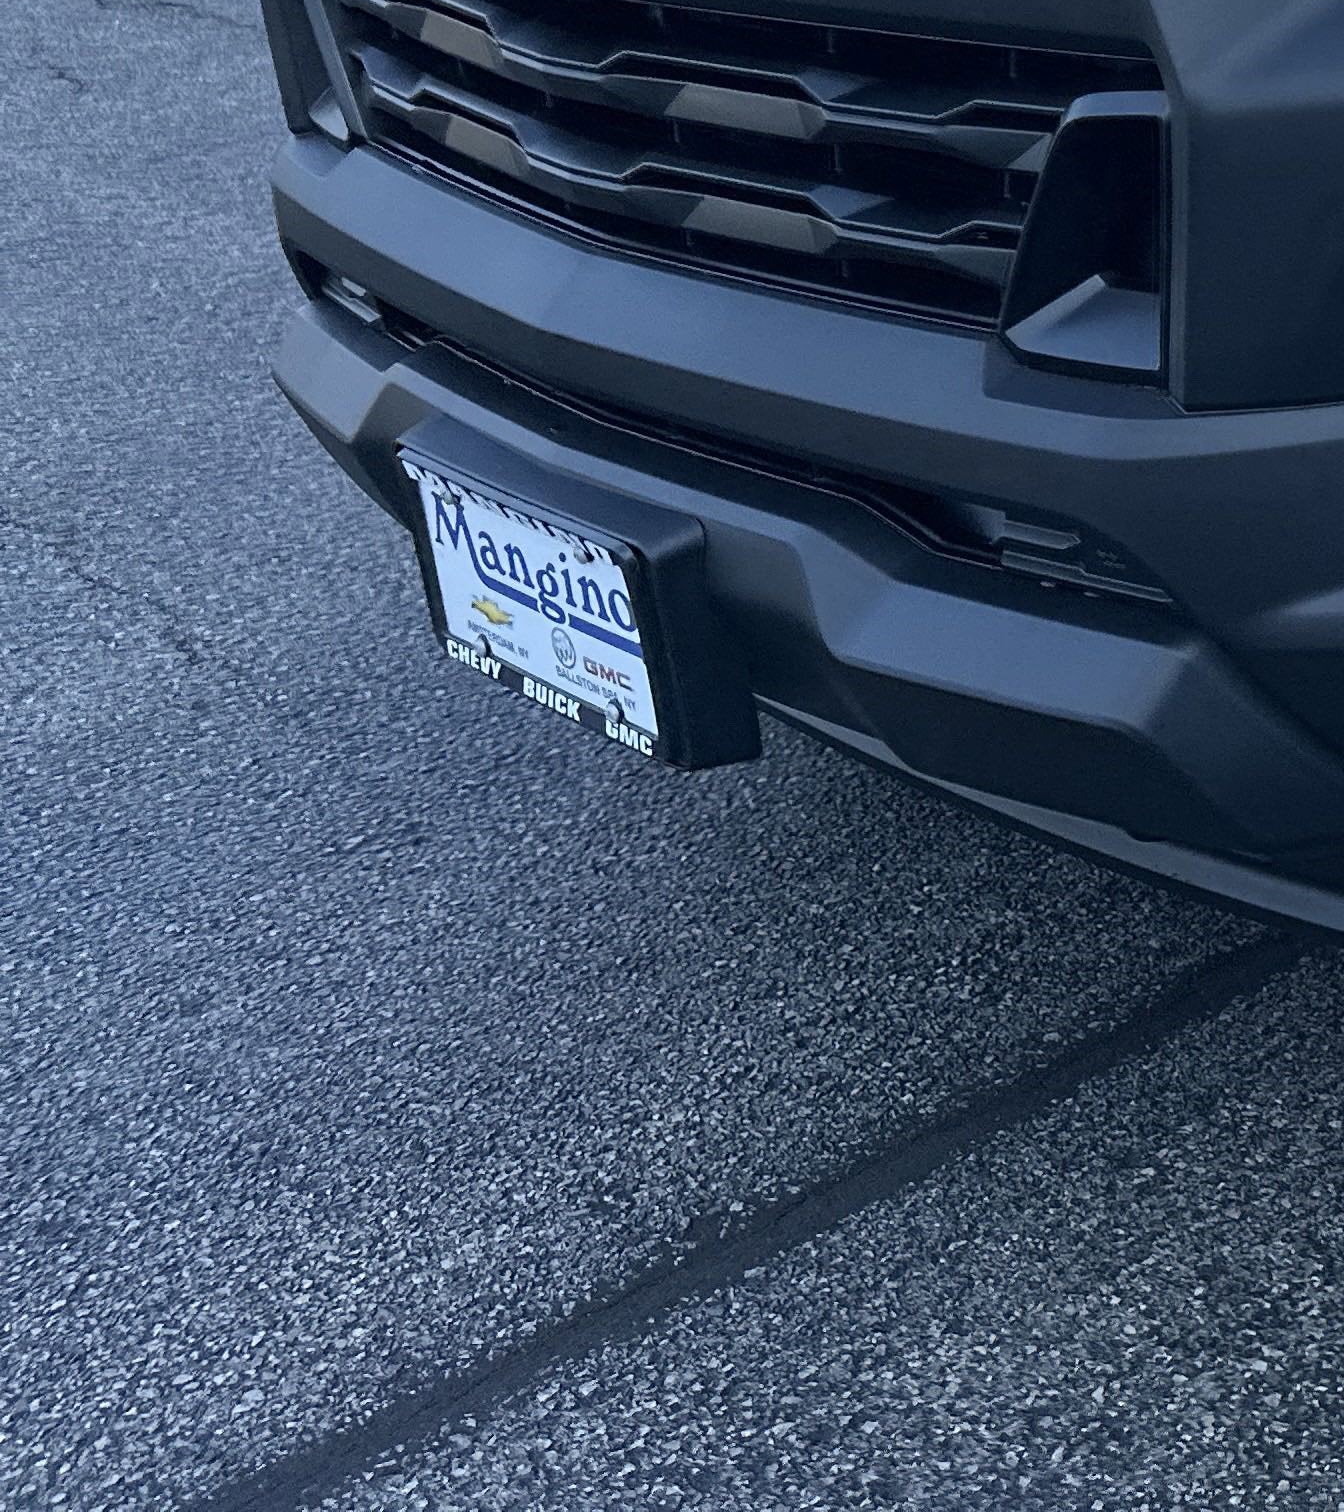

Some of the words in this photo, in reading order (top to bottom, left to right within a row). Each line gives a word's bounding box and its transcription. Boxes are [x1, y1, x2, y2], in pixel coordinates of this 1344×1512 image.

[431, 490, 638, 634] Mangino
[446, 639, 502, 680] CHEVY
[523, 676, 581, 722] BUICK
[583, 655, 634, 692] GMC
